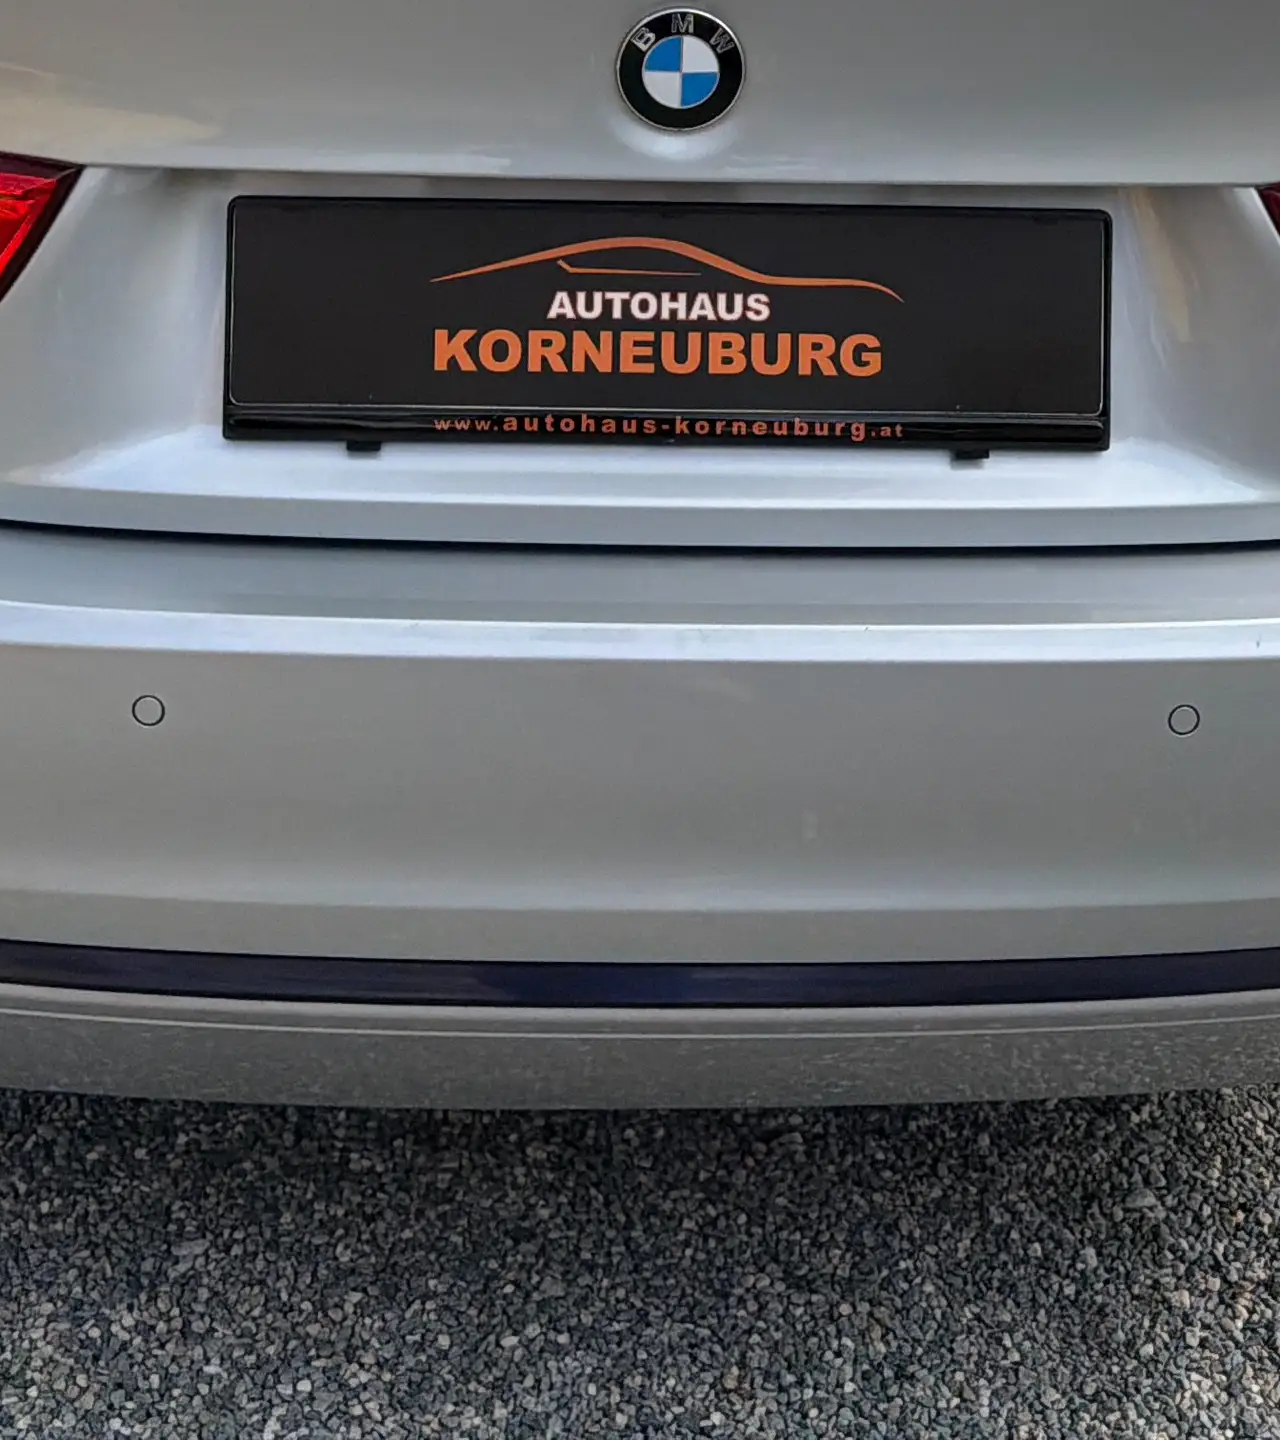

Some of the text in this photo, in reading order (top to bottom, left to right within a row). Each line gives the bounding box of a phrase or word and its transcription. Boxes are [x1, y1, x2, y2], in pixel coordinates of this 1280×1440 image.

[631, 13, 736, 53] BMW
[546, 291, 771, 322] AUTOHAUS
[433, 328, 883, 378] KORNEUBURG
[433, 413, 904, 442] www.autohaus-korneuburg.at
